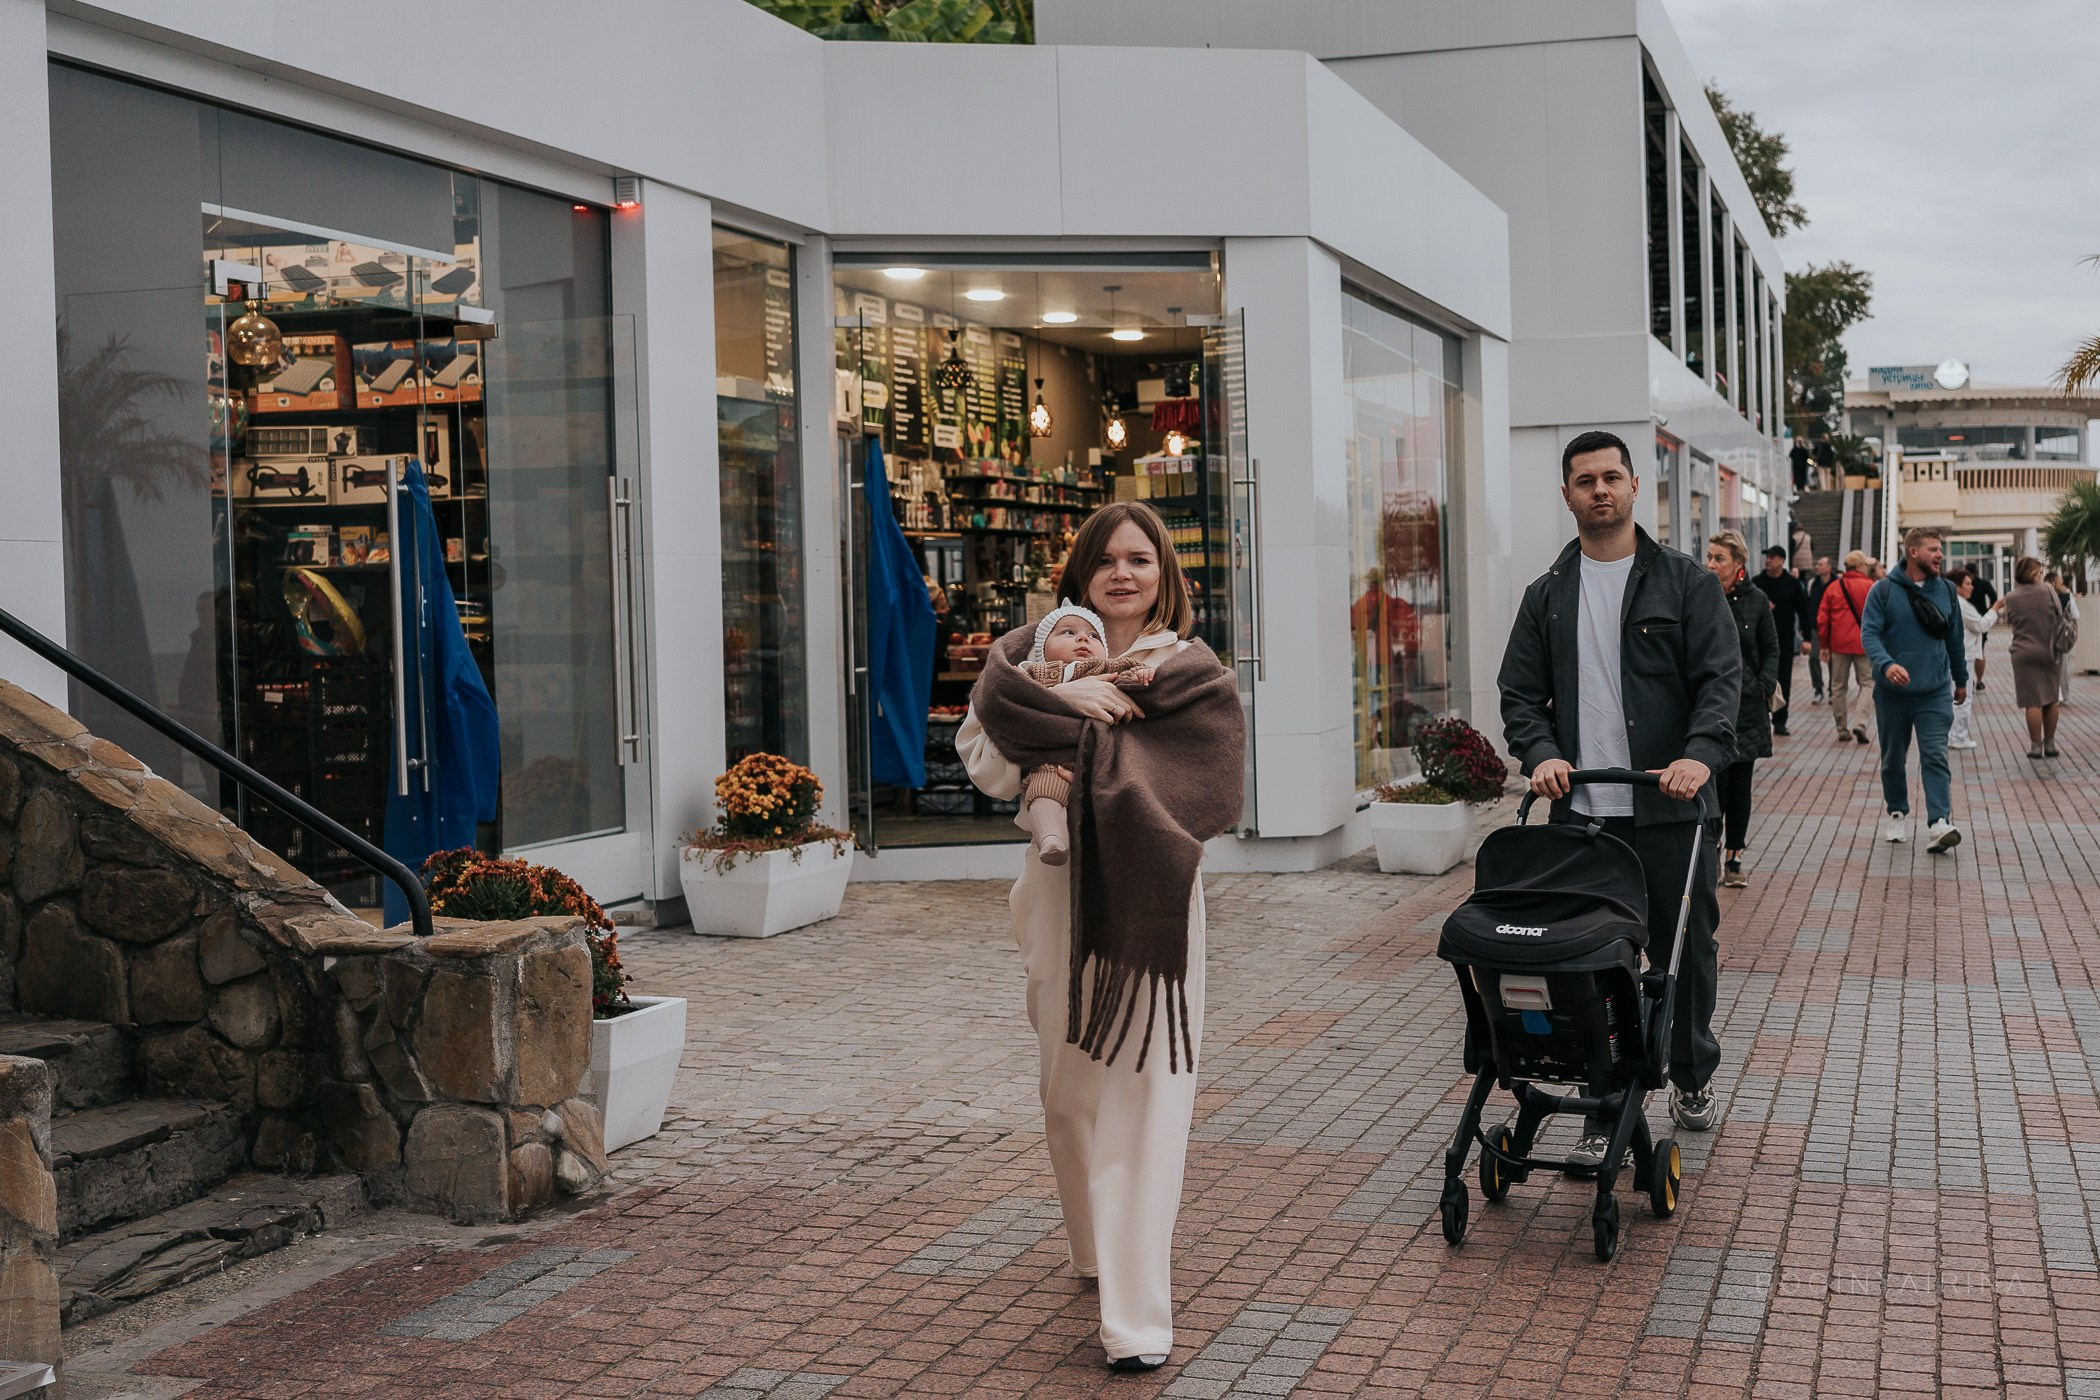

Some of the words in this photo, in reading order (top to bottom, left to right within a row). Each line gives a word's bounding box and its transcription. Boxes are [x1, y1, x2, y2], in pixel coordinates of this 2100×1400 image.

[306, 336, 334, 345] INTEX
[1881, 374, 1924, 385] устрицы
[1909, 381, 1934, 390] вино
[1495, 924, 1543, 937] doona
